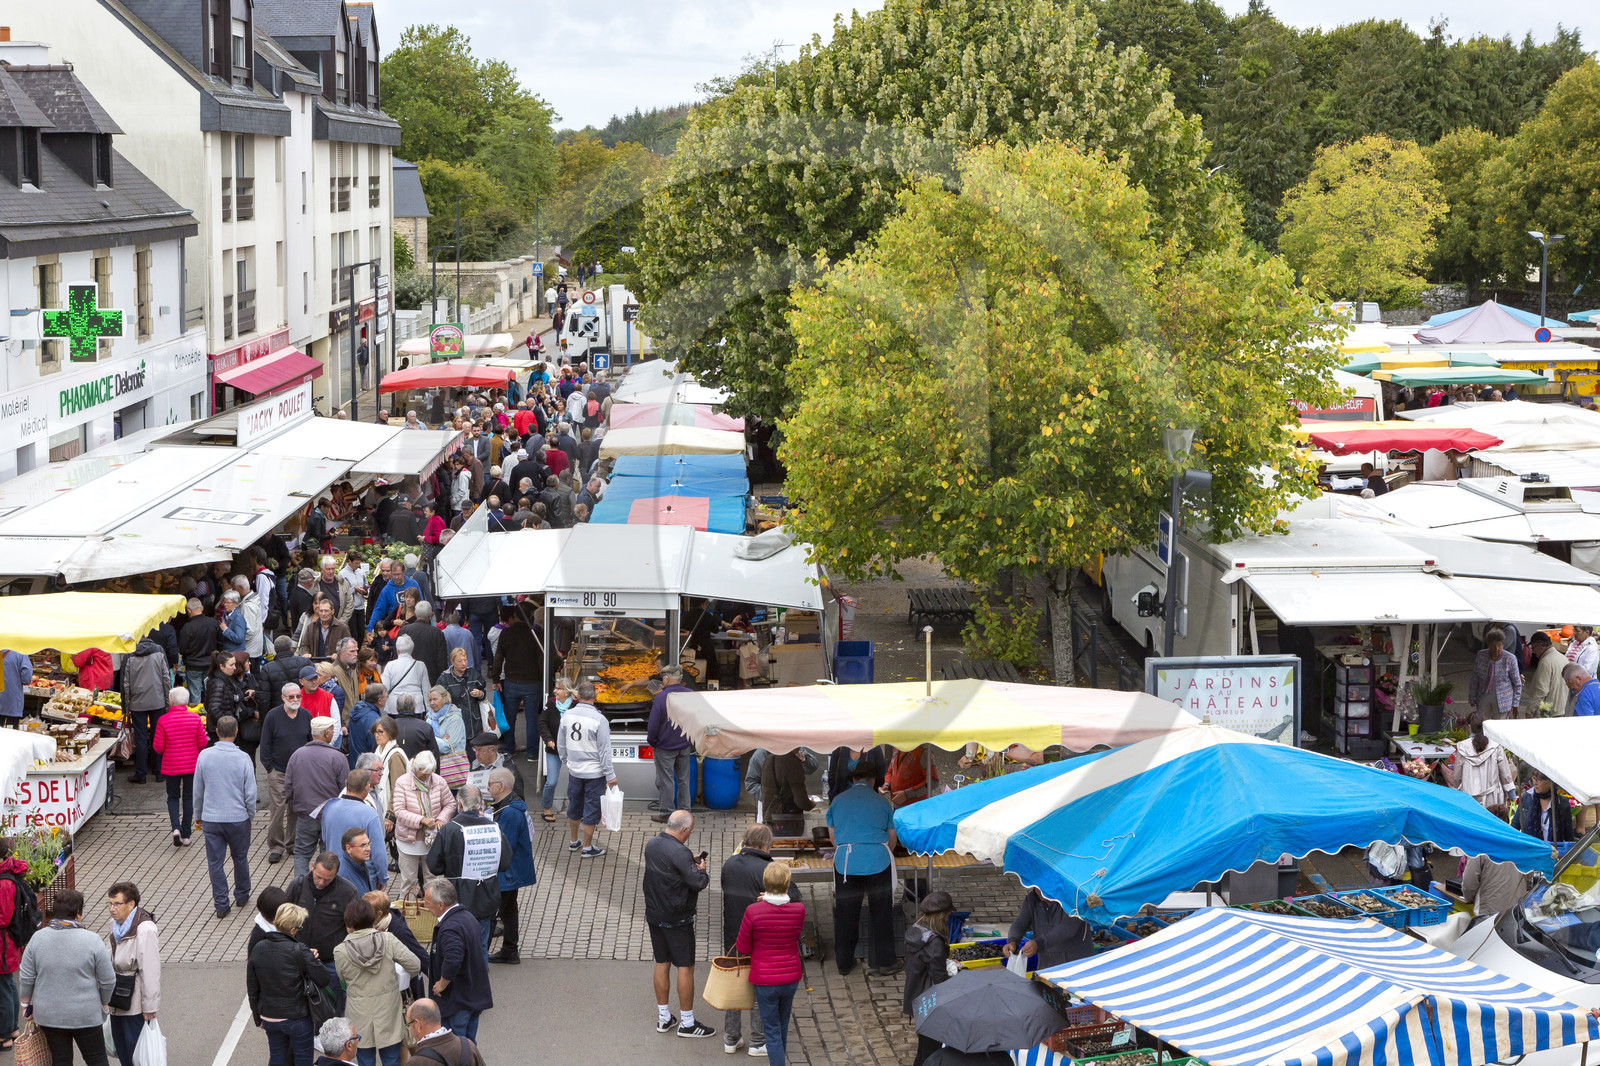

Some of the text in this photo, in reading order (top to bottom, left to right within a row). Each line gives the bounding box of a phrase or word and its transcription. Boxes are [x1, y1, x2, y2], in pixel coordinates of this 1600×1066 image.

[174, 350, 201, 370] Orthopédie
[59, 367, 145, 418] PHARMACIE Delcroix
[1, 395, 30, 419] Matériel
[20, 414, 48, 439] Médical
[583, 592, 617, 607] 80 90
[1174, 676, 1277, 690] JARDINS
[1172, 694, 1278, 709] CHÂTEAU
[570, 722, 582, 741] 8
[613, 749, 629, 757] 8-HS
[38, 780, 60, 803] DE
[65, 777, 79, 802] LA
